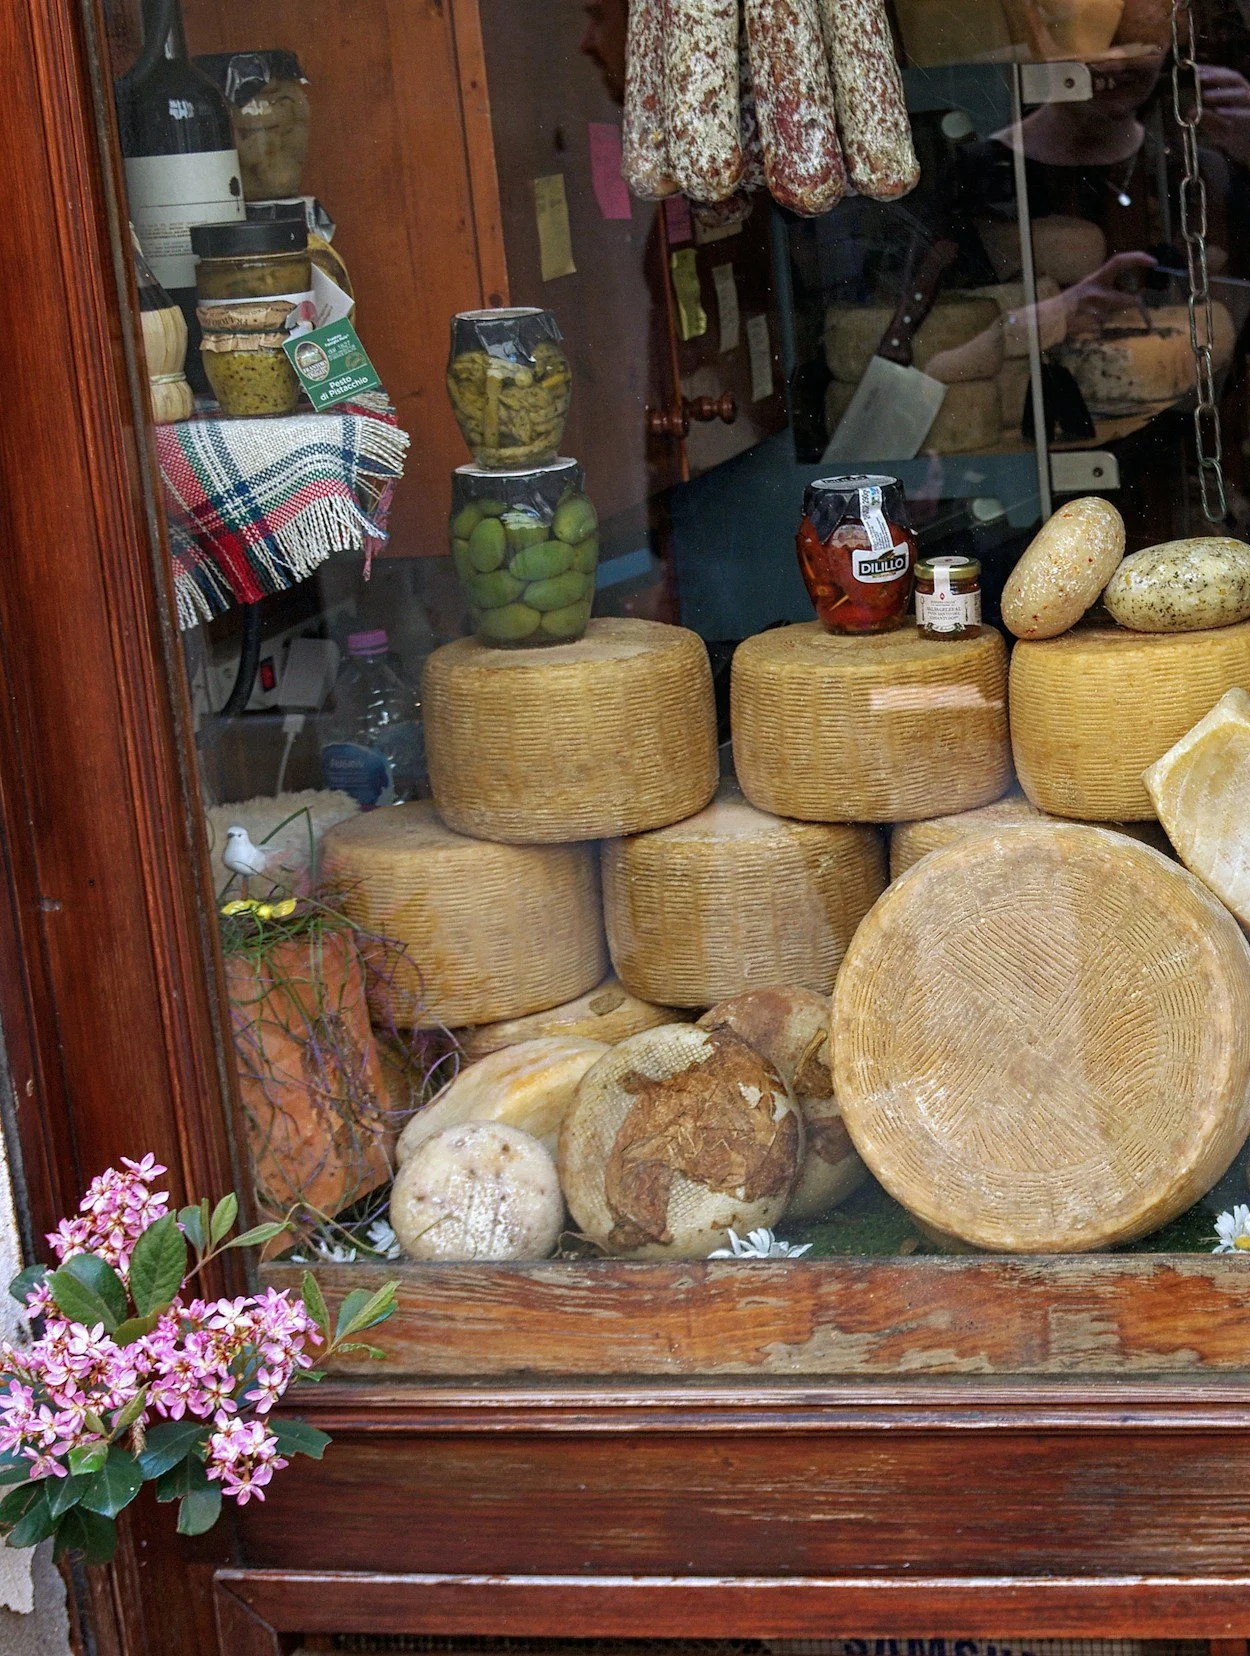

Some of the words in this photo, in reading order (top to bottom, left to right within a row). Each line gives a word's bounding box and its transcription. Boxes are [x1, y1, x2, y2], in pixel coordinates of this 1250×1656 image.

[320, 392, 330, 401] di
[329, 376, 368, 397] Pistacchio
[329, 376, 352, 390] Pesto
[861, 557, 904, 573] DILILLO
